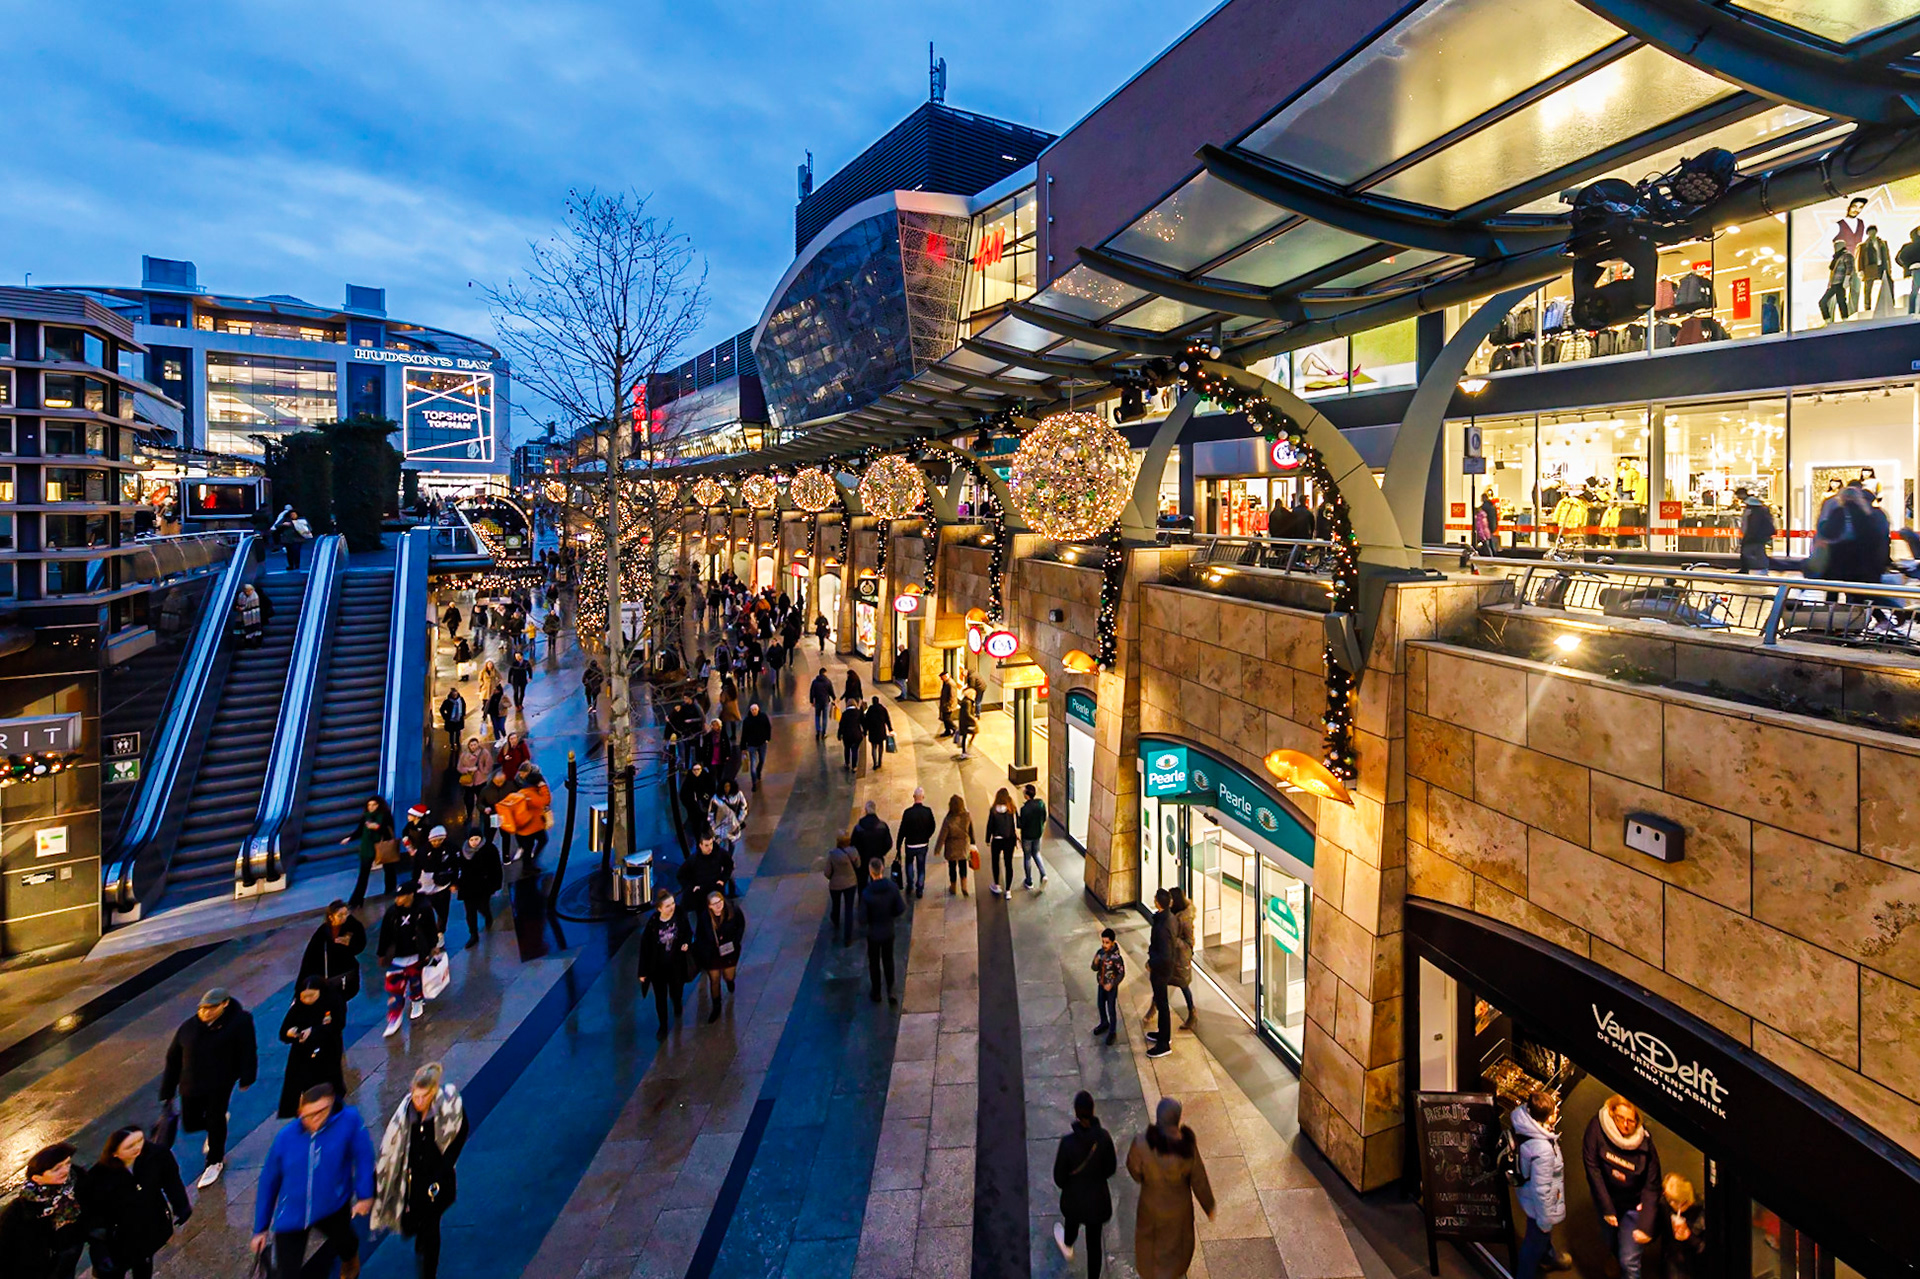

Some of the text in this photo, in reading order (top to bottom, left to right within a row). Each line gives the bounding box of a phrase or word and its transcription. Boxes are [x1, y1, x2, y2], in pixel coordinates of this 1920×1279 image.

[1736, 282, 1747, 303] SALE
[354, 348, 493, 370] HUDSON'S BAY
[422, 410, 478, 422] TOPSHOP
[427, 420, 471, 430] TOPMAN
[1674, 528, 1698, 536] SALE
[1713, 529, 1740, 537] SALE
[1072, 698, 1090, 717] Pearle
[1148, 770, 1186, 785] Pearle
[1219, 783, 1252, 815] Pearle
[1592, 1003, 1729, 1104] Van Delft
[1597, 1031, 1727, 1119] DE PEPERNOTENFABRIEK
[1633, 1065, 1659, 1085] ANNO
